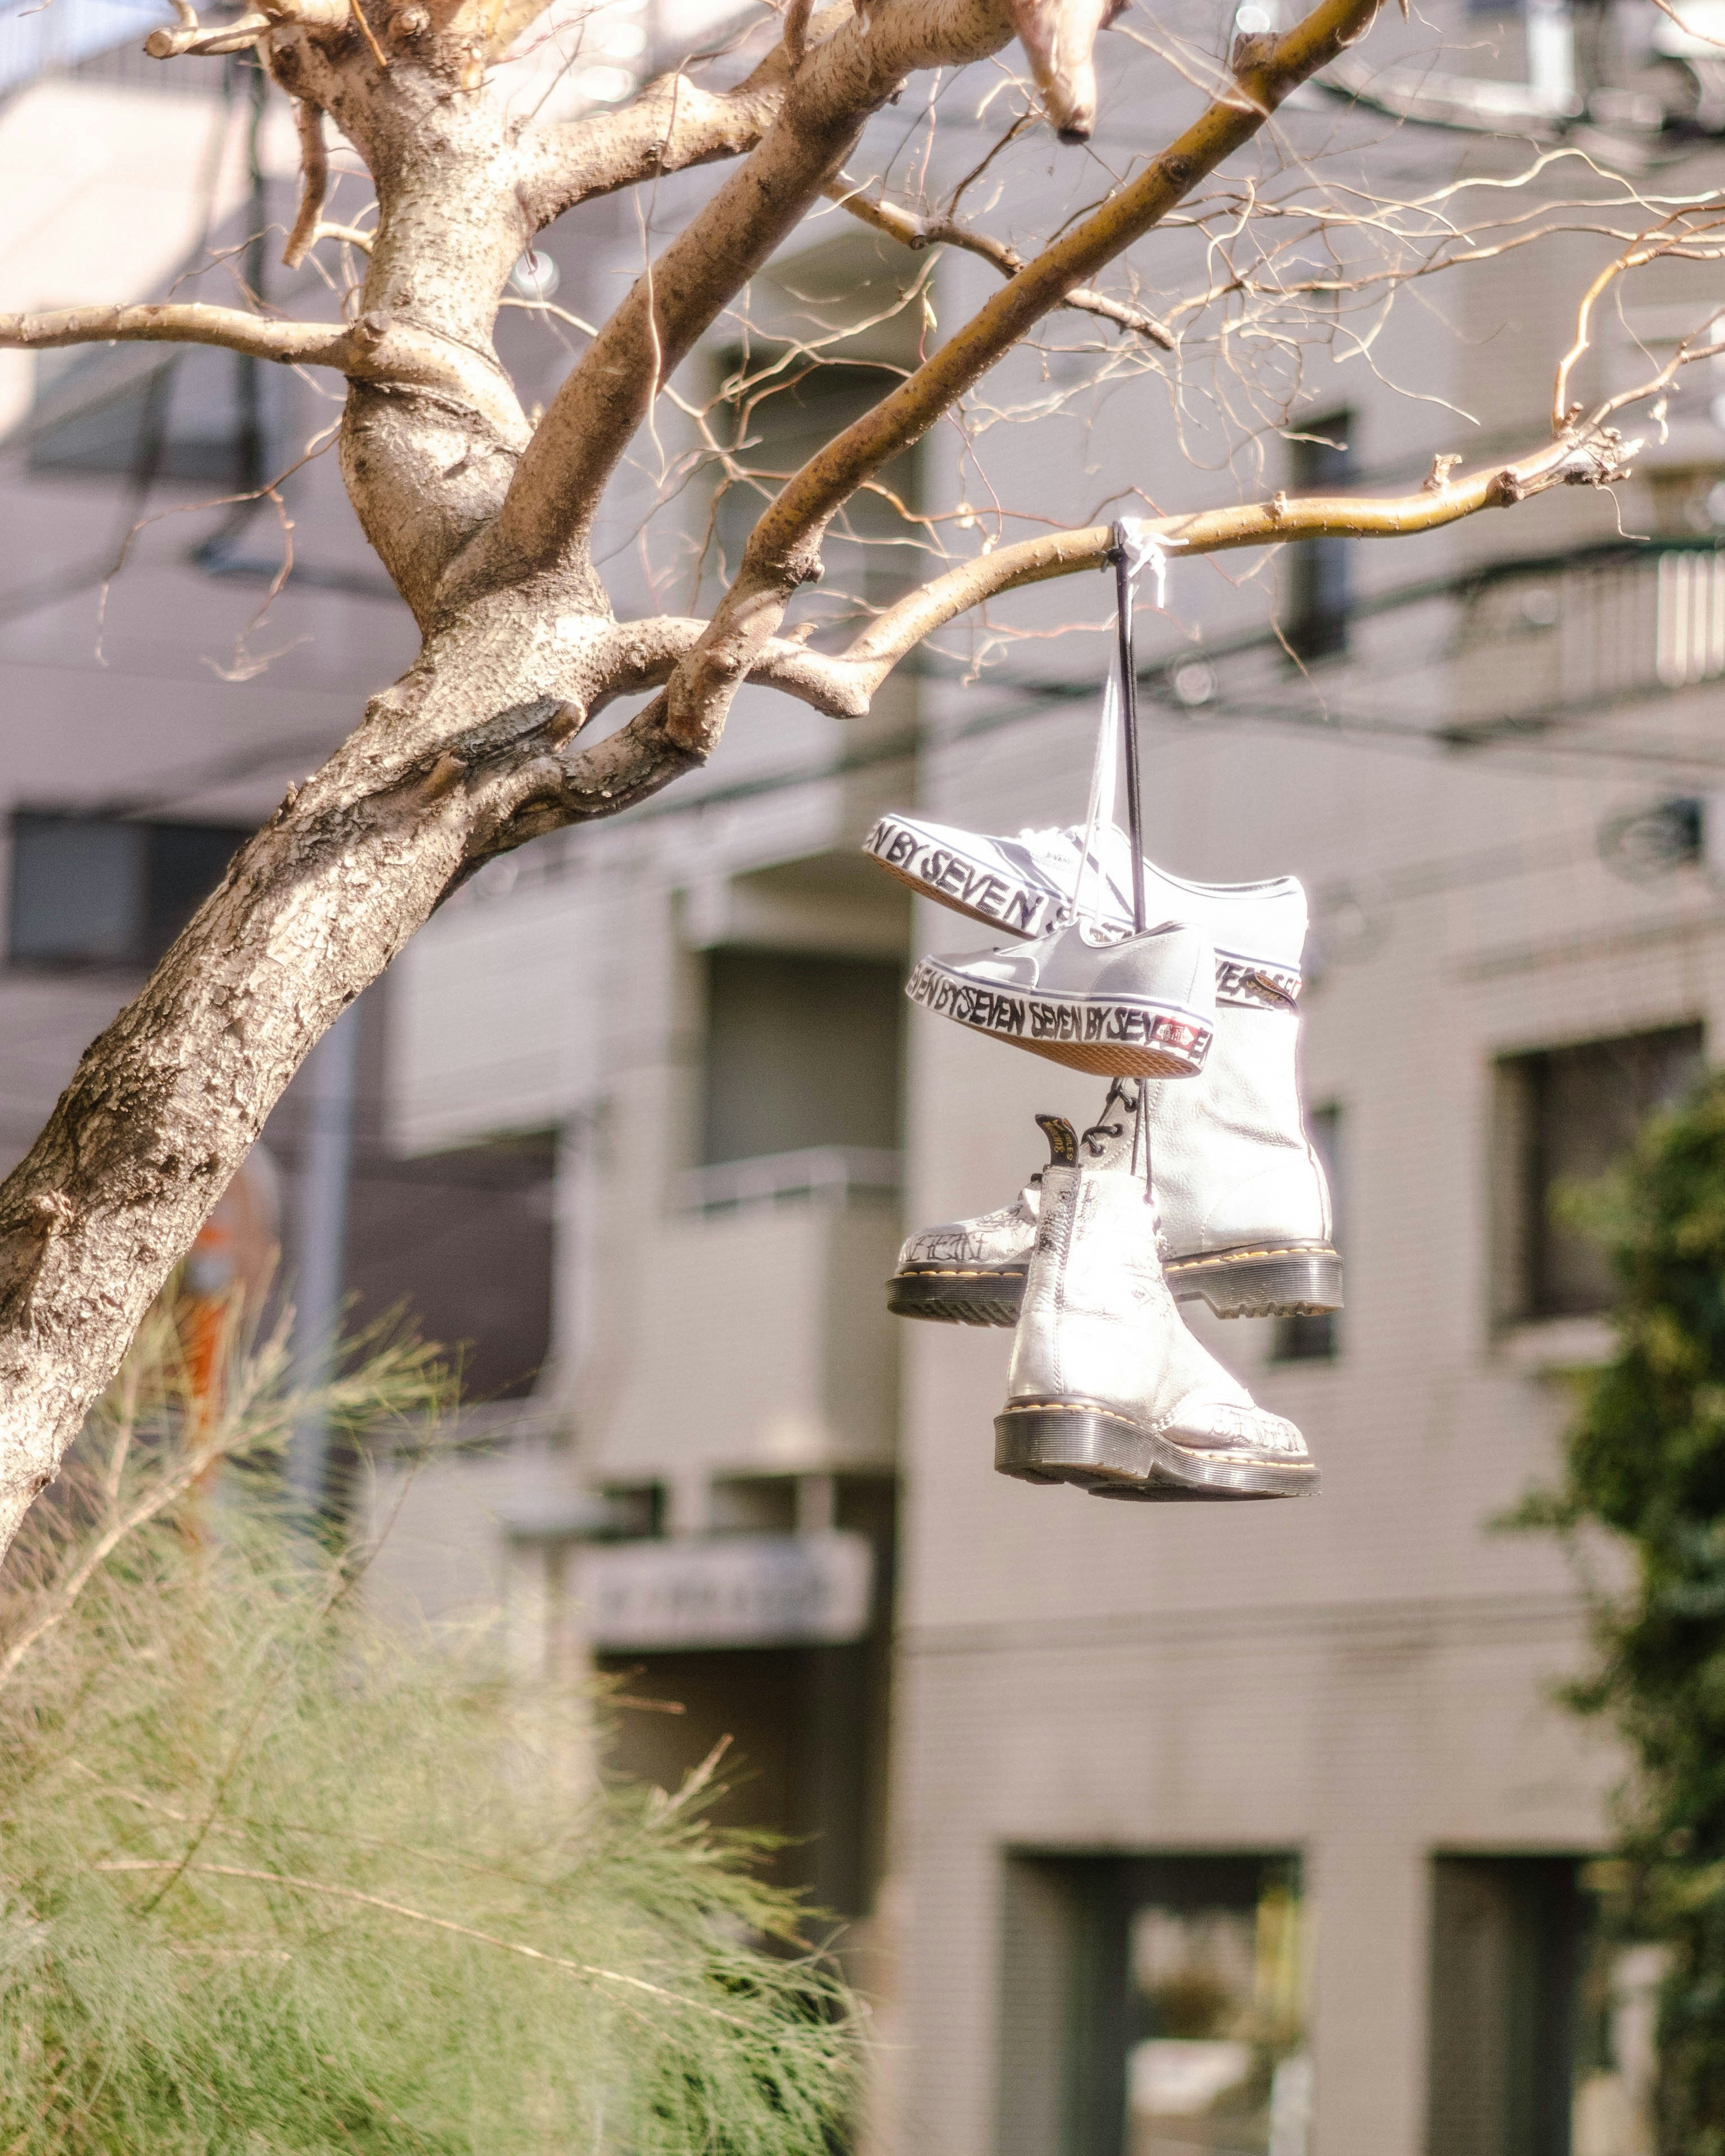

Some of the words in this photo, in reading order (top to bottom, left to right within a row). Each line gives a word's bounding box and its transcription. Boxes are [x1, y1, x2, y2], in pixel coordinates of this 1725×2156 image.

[886, 831, 930, 870] BY
[920, 849, 1045, 930] SEVEN
[957, 986, 1026, 1036] SEVEN
[1029, 1002, 1083, 1042] SEVEN
[1084, 1006, 1112, 1041] BY
